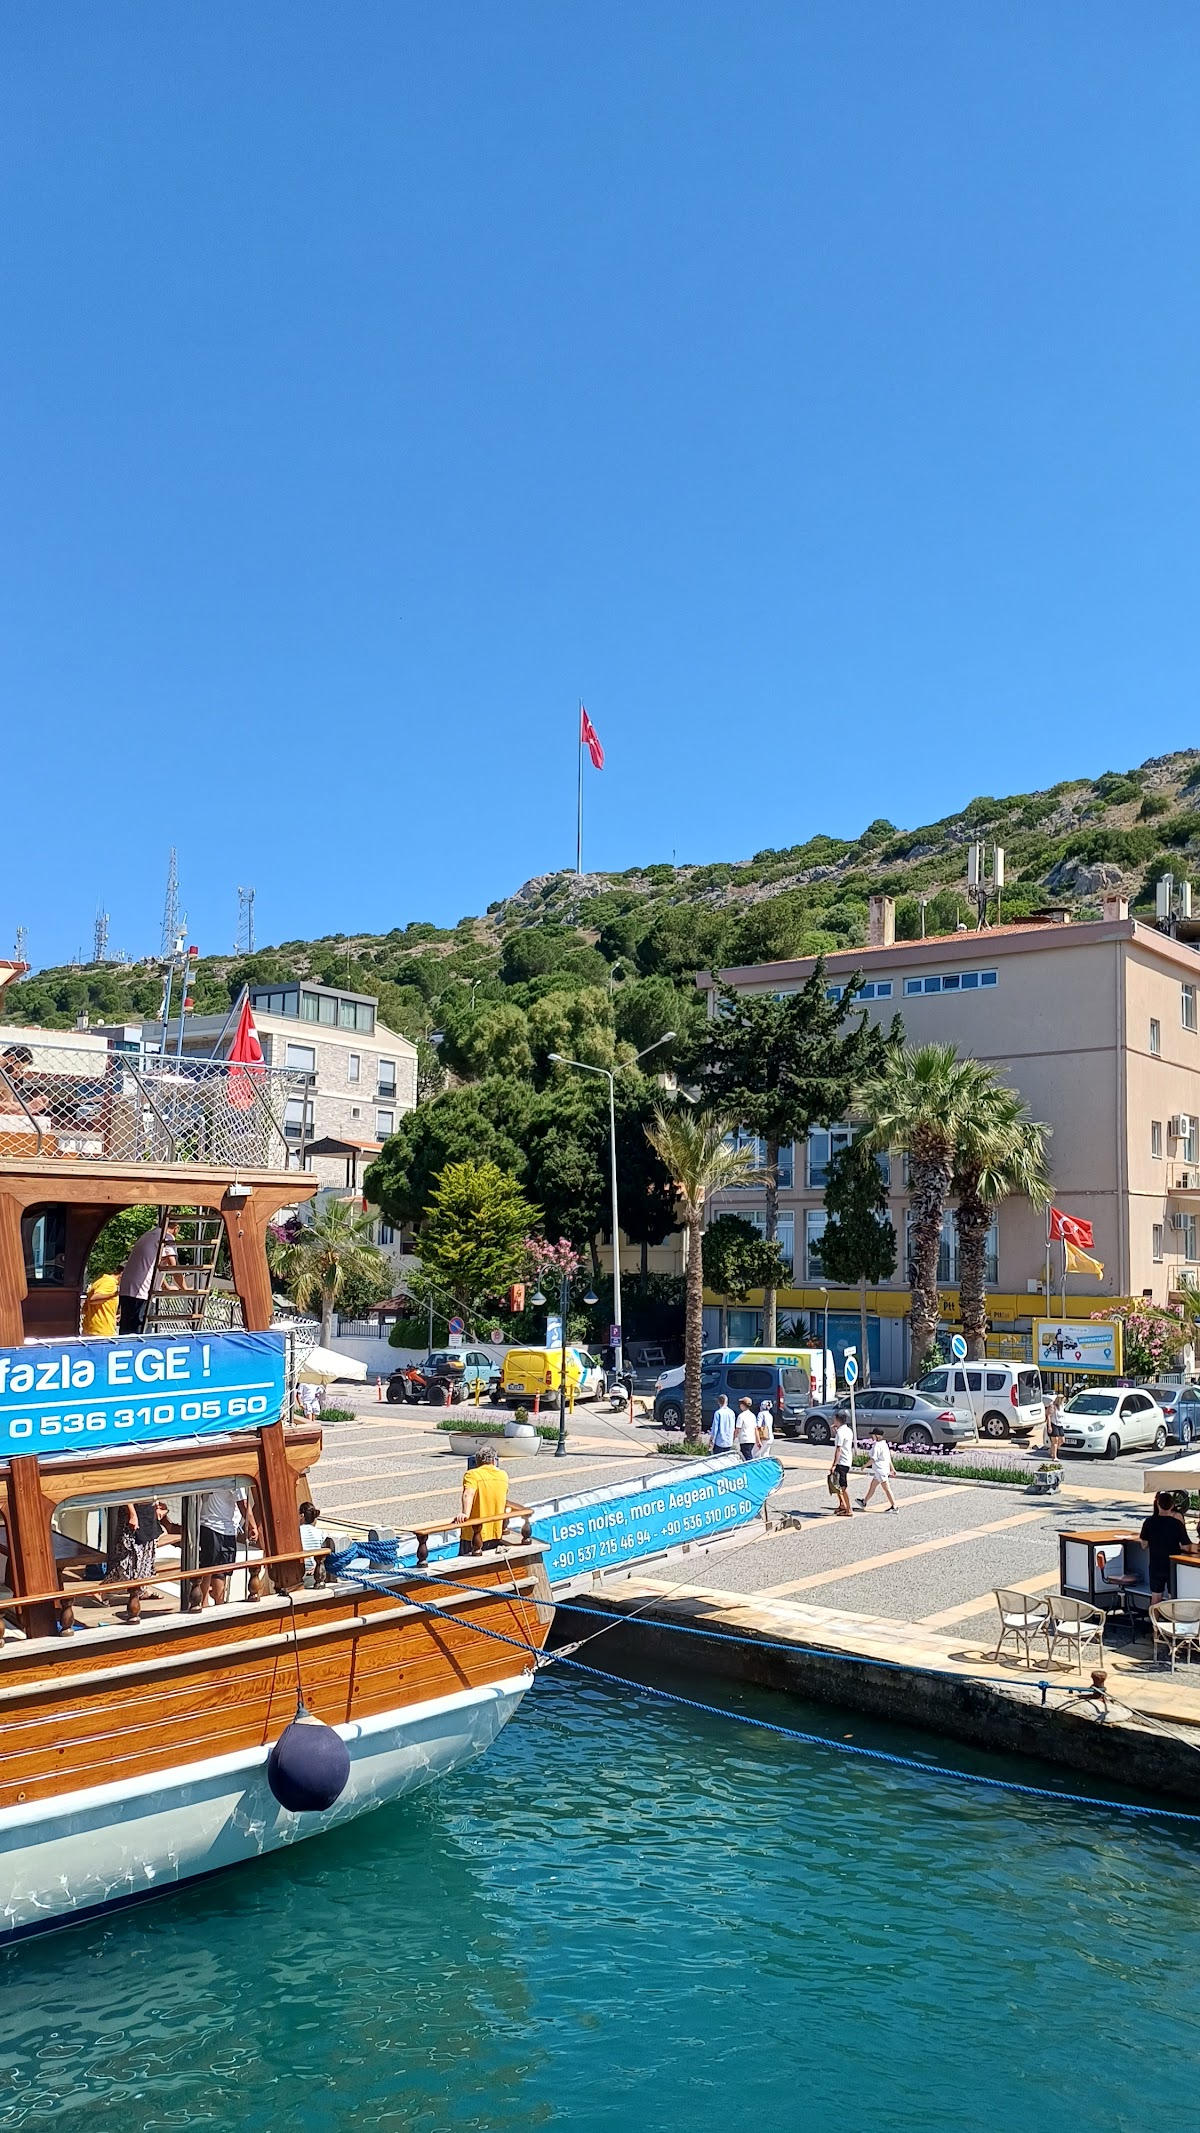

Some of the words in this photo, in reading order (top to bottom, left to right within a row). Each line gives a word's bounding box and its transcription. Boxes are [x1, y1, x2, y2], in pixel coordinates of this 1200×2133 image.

[943, 1301, 956, 1311] Ptt
[0, 1354, 95, 1394] fazla
[108, 1346, 190, 1386] EGE
[202, 1344, 211, 1377] !
[9, 1418, 33, 1439] 0
[39, 1411, 107, 1436] 536
[114, 1404, 175, 1429] 310
[180, 1400, 221, 1421] 05
[227, 1395, 267, 1416] 60
[552, 1521, 584, 1543] Less
[588, 1511, 629, 1534] noise,
[630, 1500, 666, 1519] more
[668, 1485, 715, 1510] Aegean
[716, 1472, 749, 1495] Blue!
[552, 1551, 575, 1569] +90
[577, 1545, 597, 1562] 537
[599, 1539, 618, 1556] 215
[620, 1533, 635, 1549] 46
[637, 1528, 651, 1545] 94
[660, 1521, 681, 1537] +90
[683, 1514, 703, 1531] 536
[704, 1508, 722, 1525] 310
[724, 1504, 737, 1520] 05
[739, 1500, 752, 1516] 60
